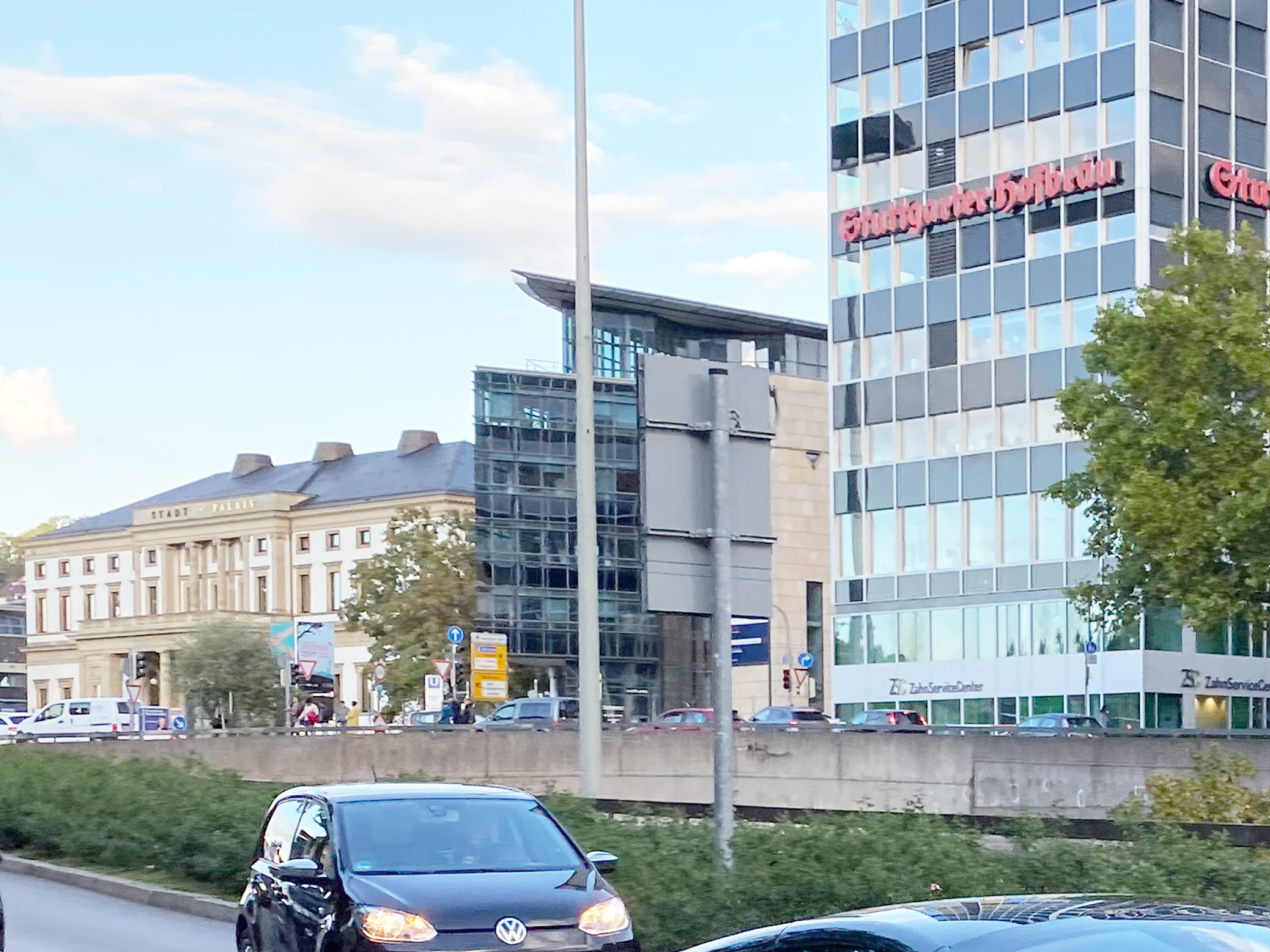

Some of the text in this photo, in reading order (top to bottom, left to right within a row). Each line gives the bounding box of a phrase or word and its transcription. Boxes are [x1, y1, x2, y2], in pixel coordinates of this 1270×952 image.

[839, 154, 1118, 242] Stuttgarter Hofbräu
[151, 499, 255, 520] STADT PALAIS
